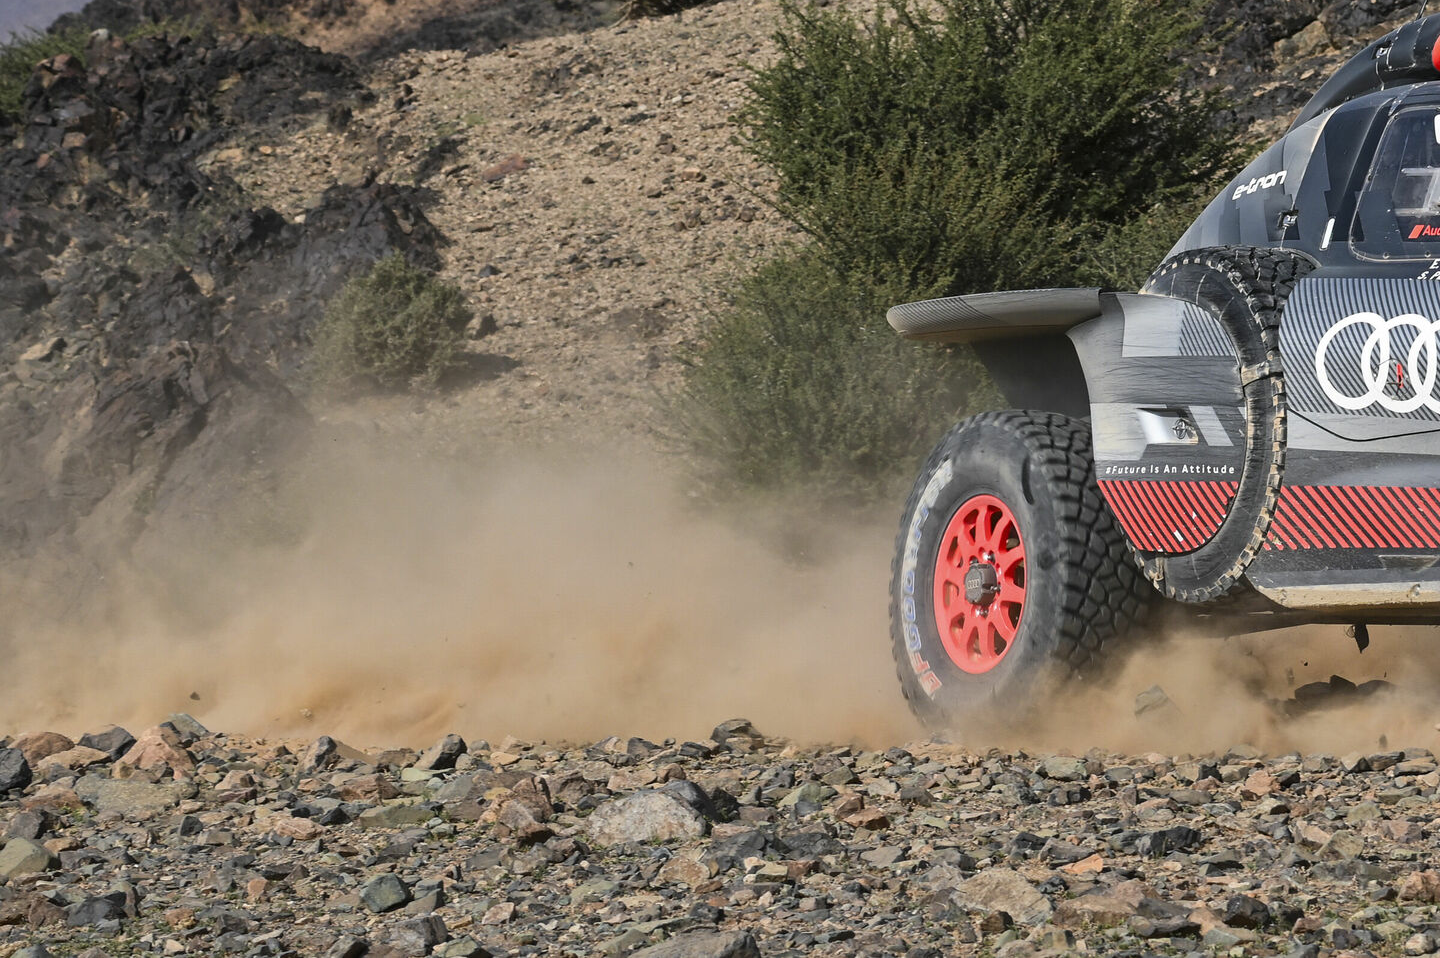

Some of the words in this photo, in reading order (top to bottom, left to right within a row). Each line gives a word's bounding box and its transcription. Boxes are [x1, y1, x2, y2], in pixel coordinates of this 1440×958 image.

[1232, 170, 1288, 201] e-tron
[1429, 258, 1440, 270] E.
[1105, 465, 1147, 475] #Future
[1150, 464, 1160, 475] Is
[1163, 464, 1177, 474] An
[1181, 464, 1236, 475] Attitude
